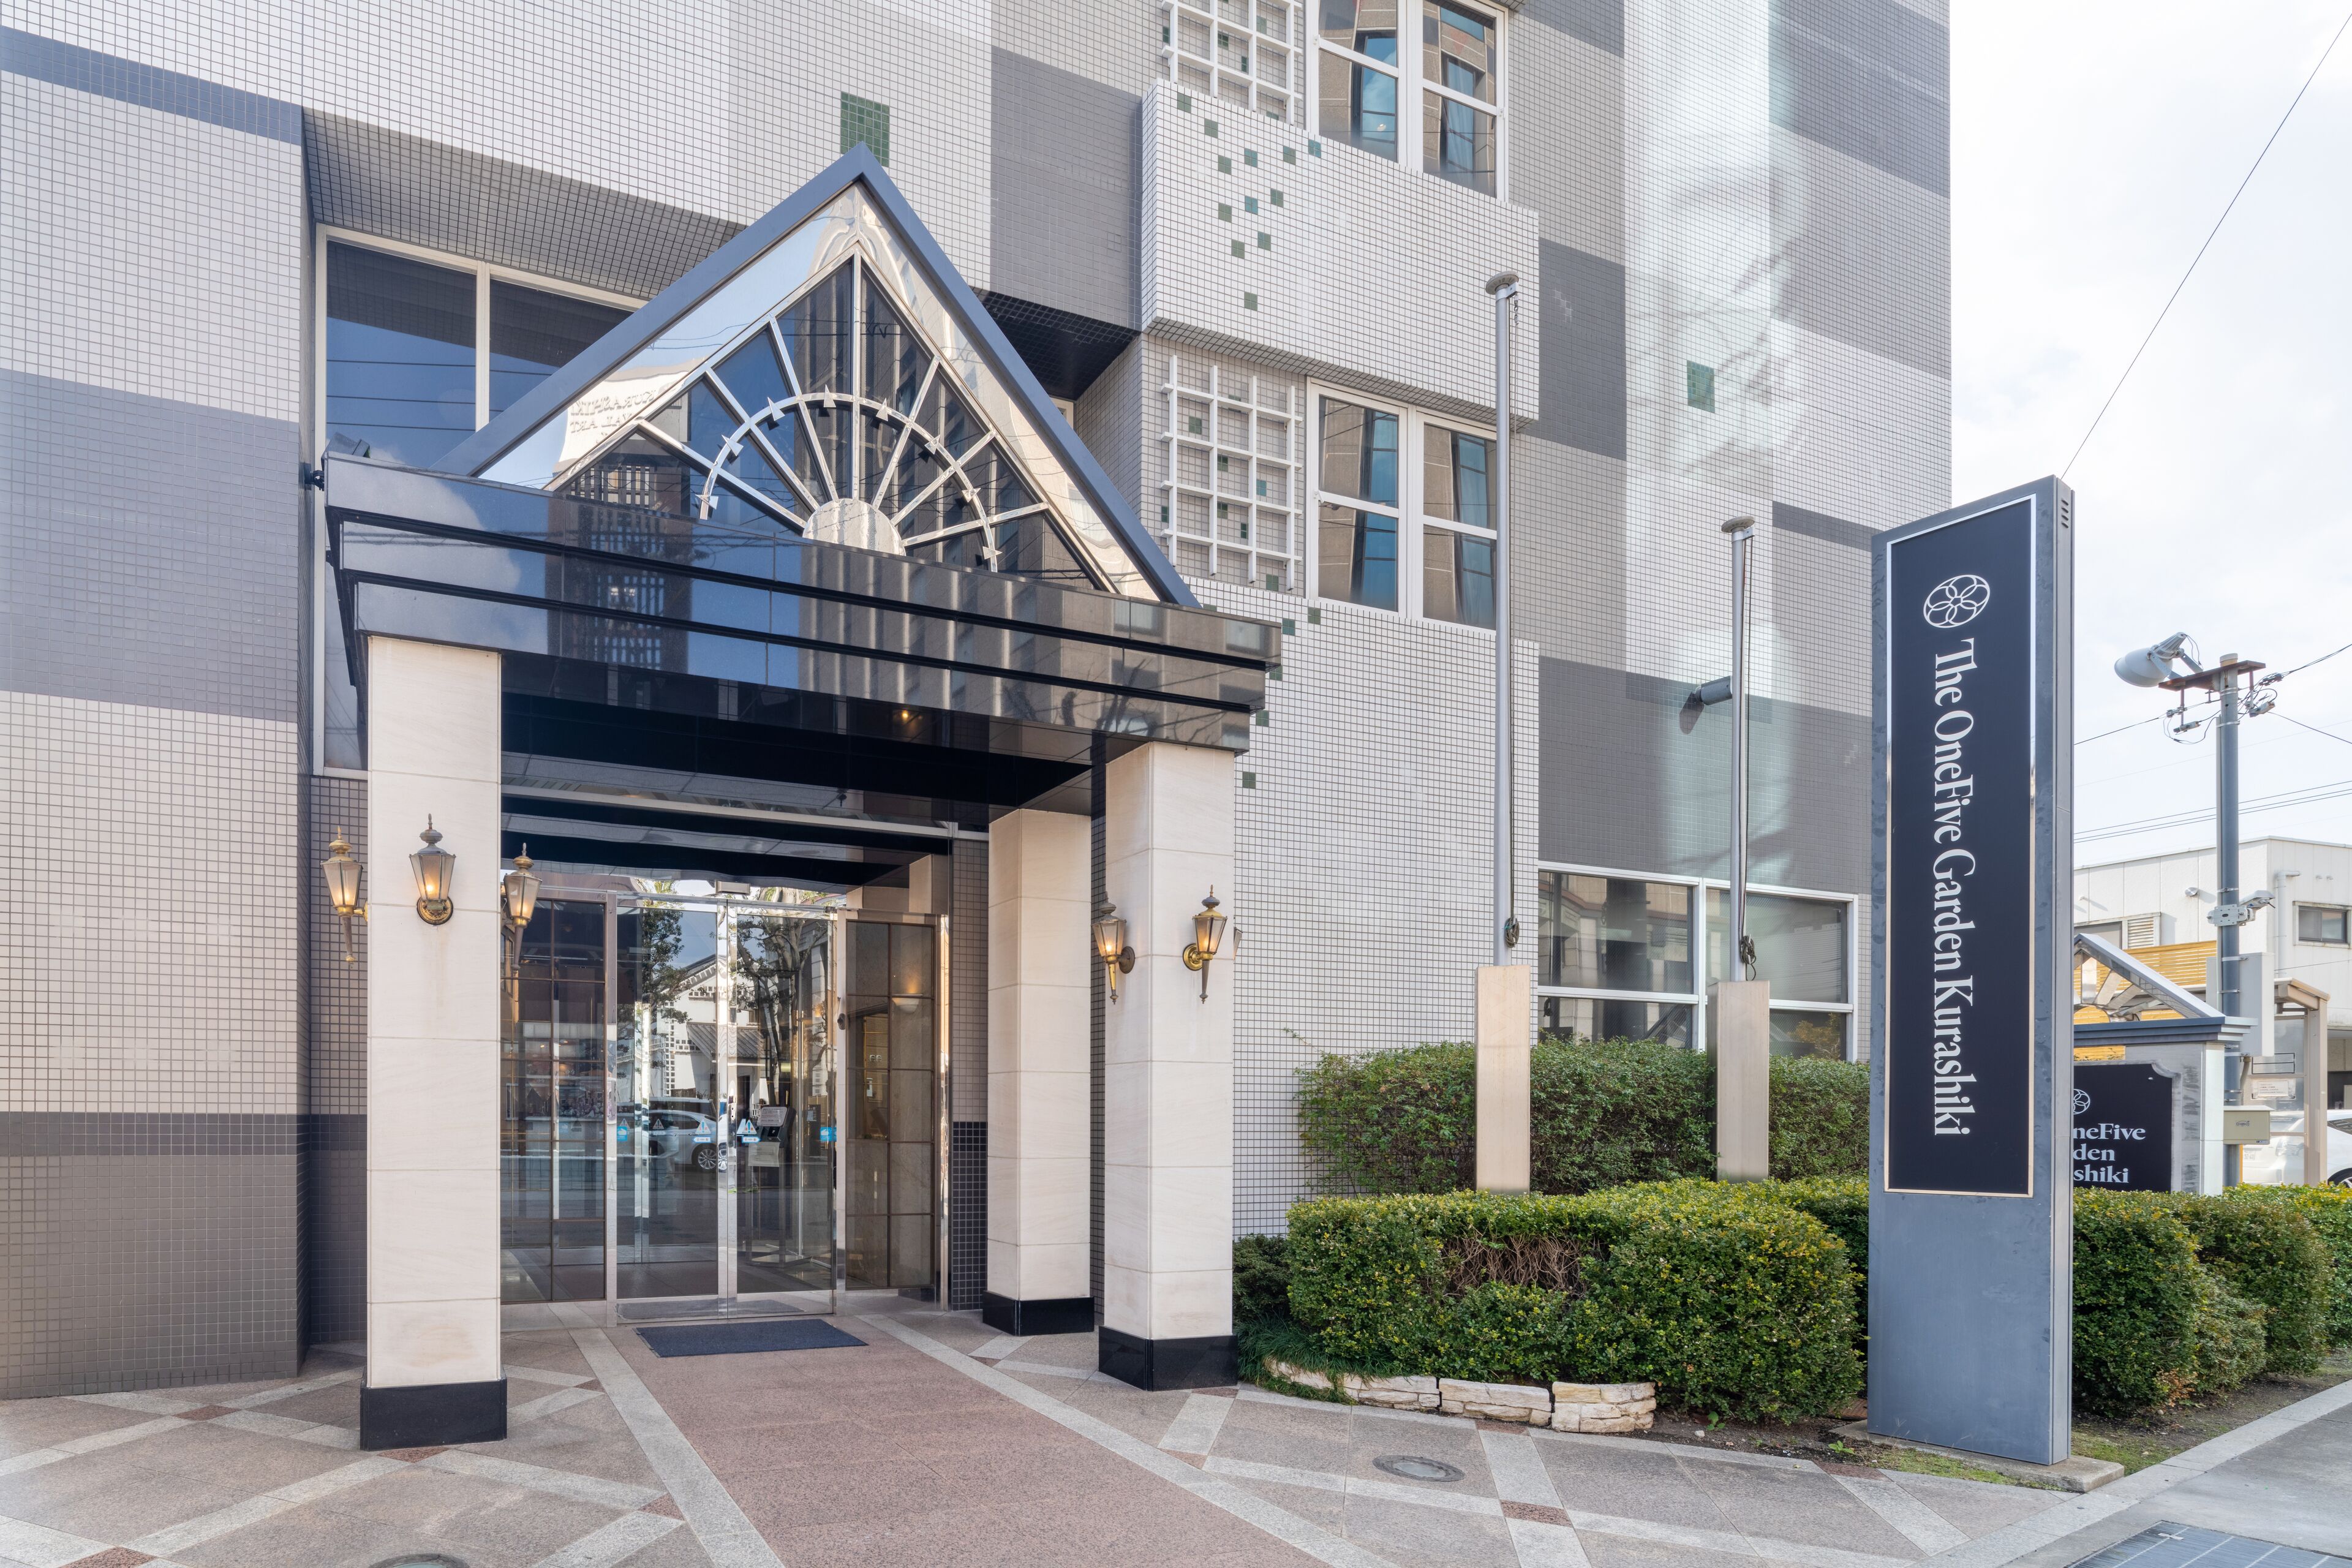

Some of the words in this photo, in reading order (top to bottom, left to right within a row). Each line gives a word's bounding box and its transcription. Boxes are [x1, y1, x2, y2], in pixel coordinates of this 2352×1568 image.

[1934, 638, 1978, 707] The
[1934, 710, 1974, 844] OneFive
[1932, 848, 1976, 973] Garden
[1934, 974, 1977, 1136] Kurashiki
[2073, 1123, 2146, 1140] neFive
[2073, 1143, 2116, 1161] den
[2073, 1164, 2129, 1183] shiki
